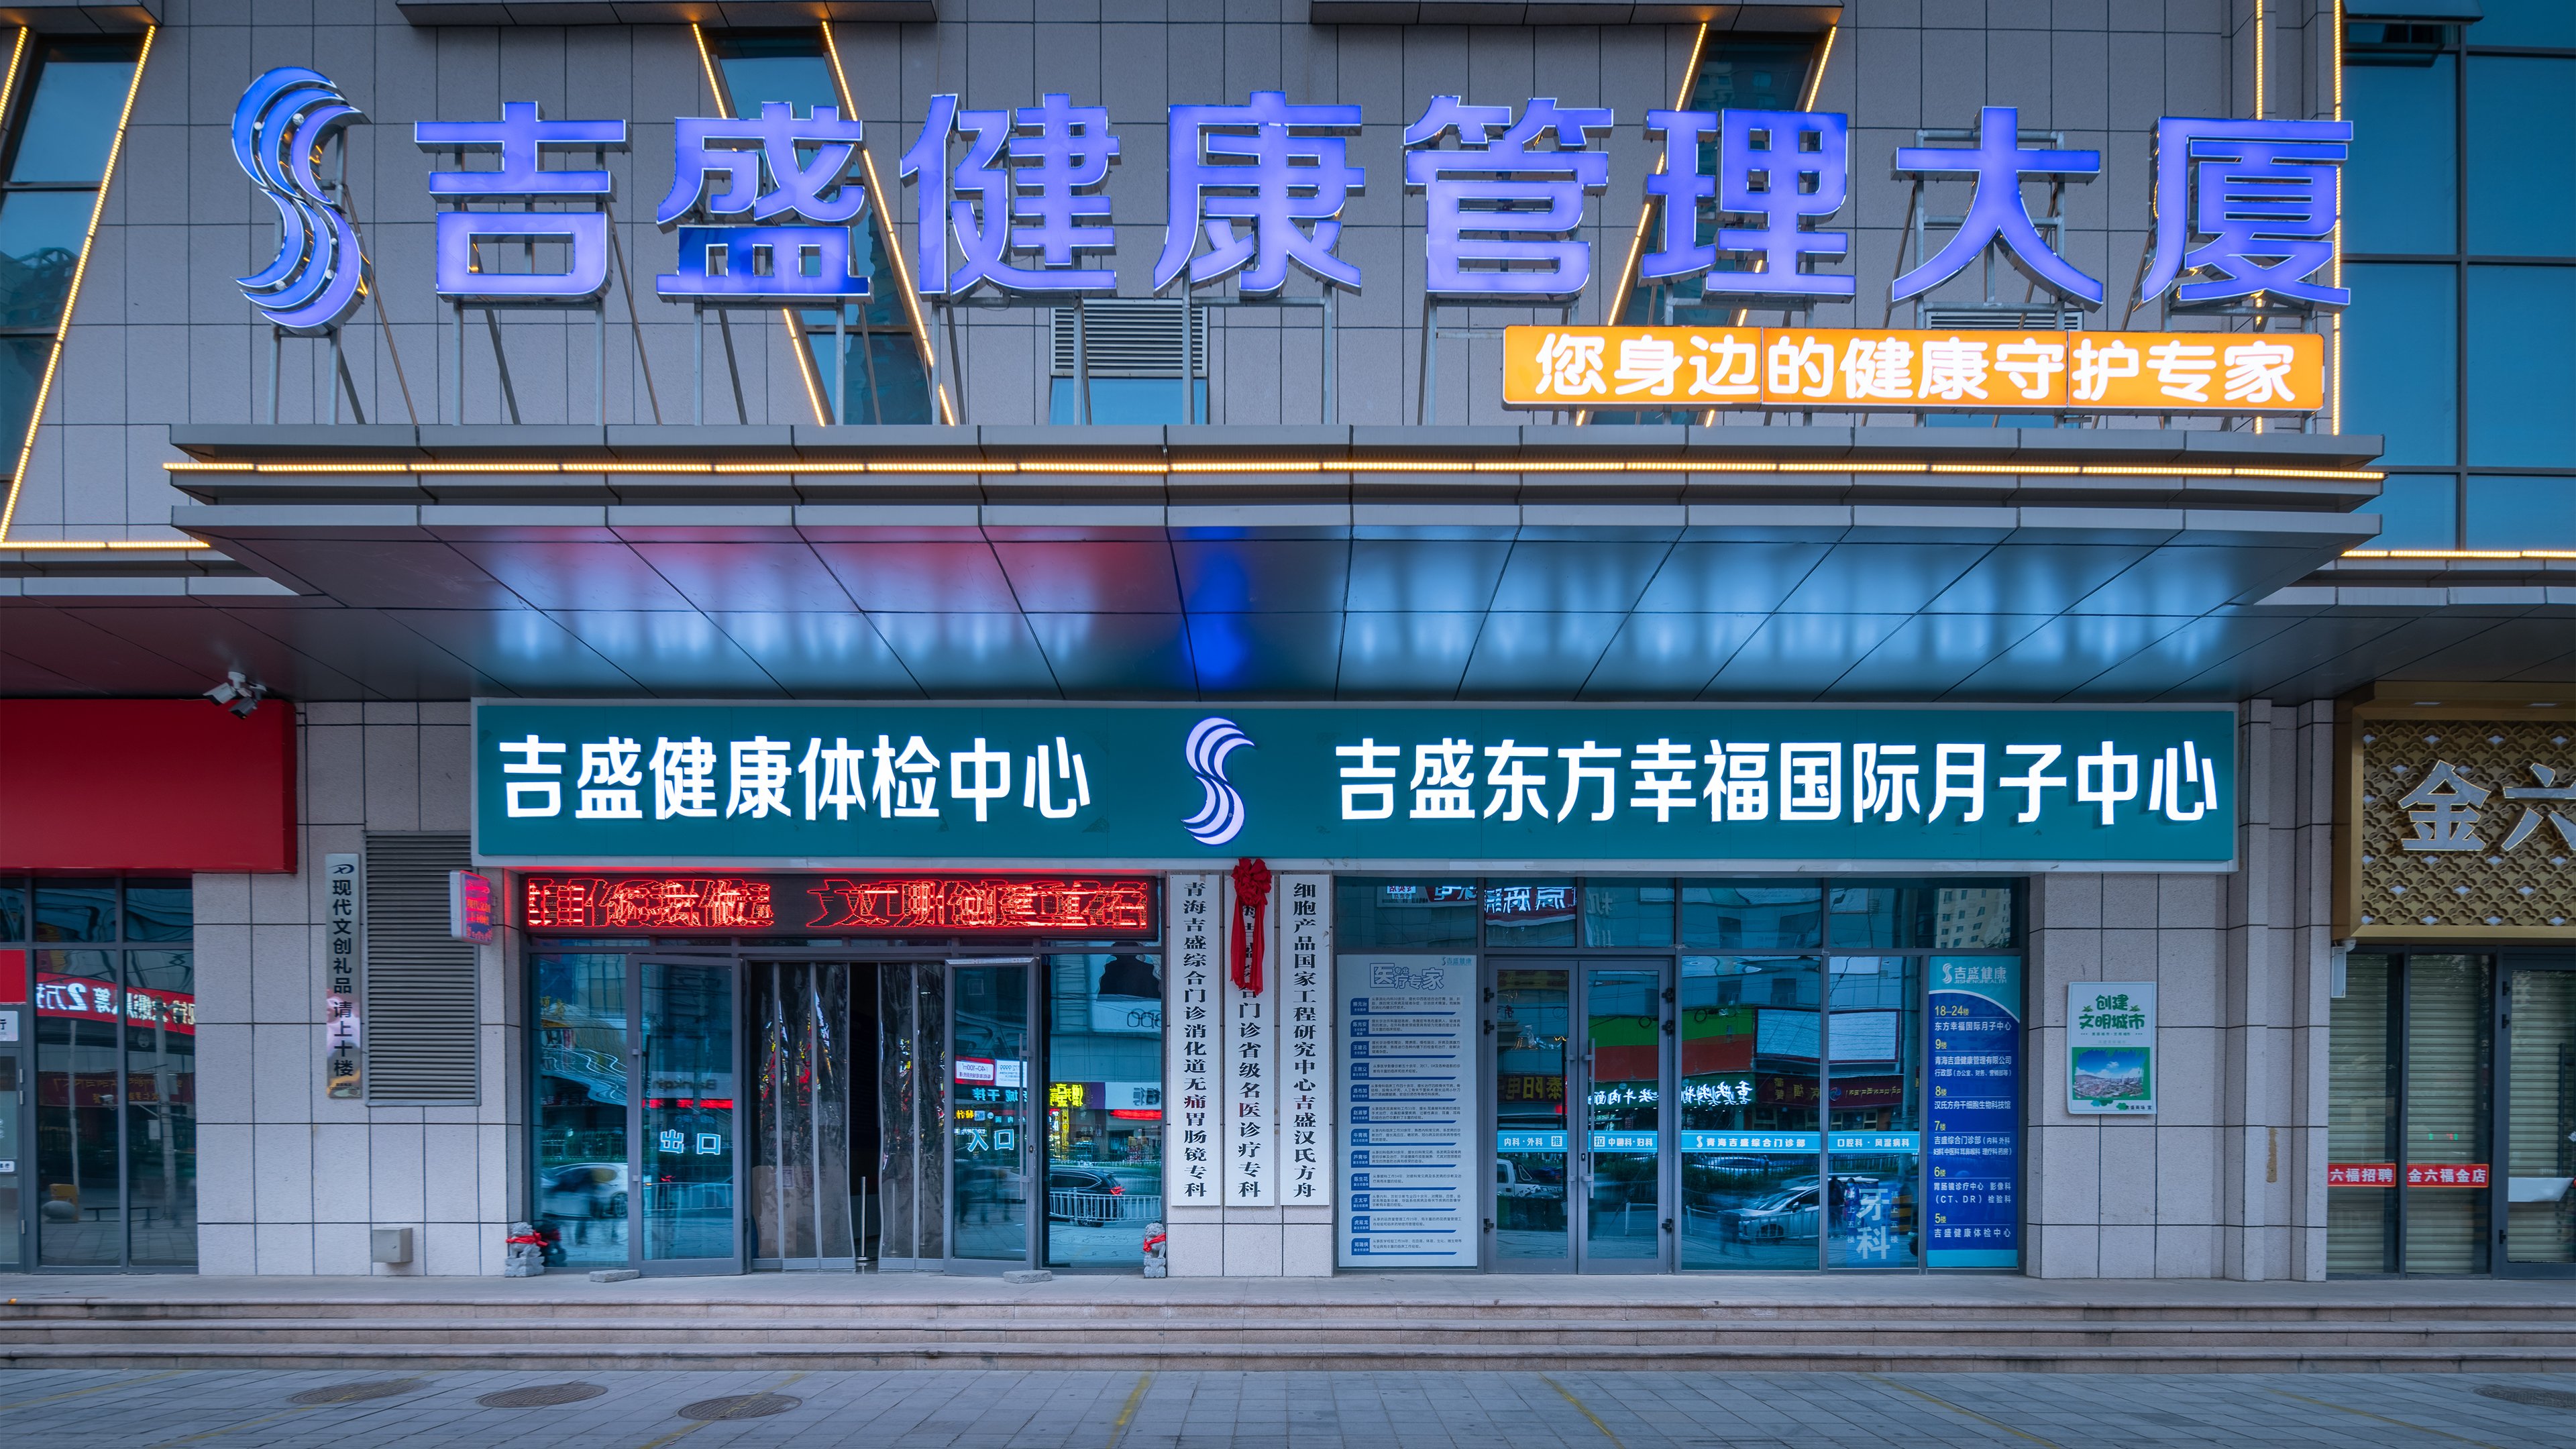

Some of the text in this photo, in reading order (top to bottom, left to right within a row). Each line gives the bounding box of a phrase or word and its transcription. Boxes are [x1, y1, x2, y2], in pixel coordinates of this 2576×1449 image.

[414, 91, 2354, 311] 吉盛健康管理大厦
[1534, 334, 2295, 403] 您身边的健康守护专家
[499, 735, 1091, 822] 吉盛健康体检中心
[1335, 737, 2218, 824] 吉盛东方幸福国际月子中心
[2398, 759, 2576, 852] 金六
[332, 879, 352, 994] 现代文创礼品
[1369, 962, 1444, 991] 医疗专家
[1954, 966, 2006, 980] 吉盛健康
[2095, 994, 2129, 1011] 创建
[1934, 1021, 2012, 1031] 东方幸福国际月子中心
[2078, 1013, 2145, 1030] 文明城市
[333, 1001, 354, 1077] 请上十楼
[1183, 882, 1207, 1197] 青海吉盛综合门诊消化道无痛胃肠镜专科
[1293, 882, 1317, 1198] 细胞产品国家工程研究中心吉盛汉氏方舟
[1935, 1038, 1947, 1050] 9楼
[1238, 903, 1261, 1197] 合门诊省级名医诊疗专科
[1935, 1056, 2012, 1065] 青海吉盛健康管理有限公司
[1935, 1085, 1947, 1097] 8楼
[1934, 1101, 2011, 1110] 汉氏方舟干细胞生物科技馆
[1934, 1120, 1947, 1131] 7楼
[658, 1129, 721, 1155] 出口
[967, 1128, 1014, 1152] 入口
[1552, 1137, 1562, 1146] 推
[1595, 1137, 1605, 1146] 拉
[1705, 1138, 1807, 1148] 青海吉盛综合门诊部
[1934, 1166, 1946, 1177] 6楼
[2330, 1168, 2394, 1182] 六福招聘
[2408, 1168, 2487, 1183] 金六福金店
[1933, 1182, 2011, 1191] 胃肠镜诊疗中心 影像科
[1988, 1195, 2011, 1204] 检验科
[1856, 1188, 1890, 1260] 牙科
[1935, 1213, 1947, 1224] 5楼
[1934, 1228, 2011, 1238] 吉盛健康体检中心
